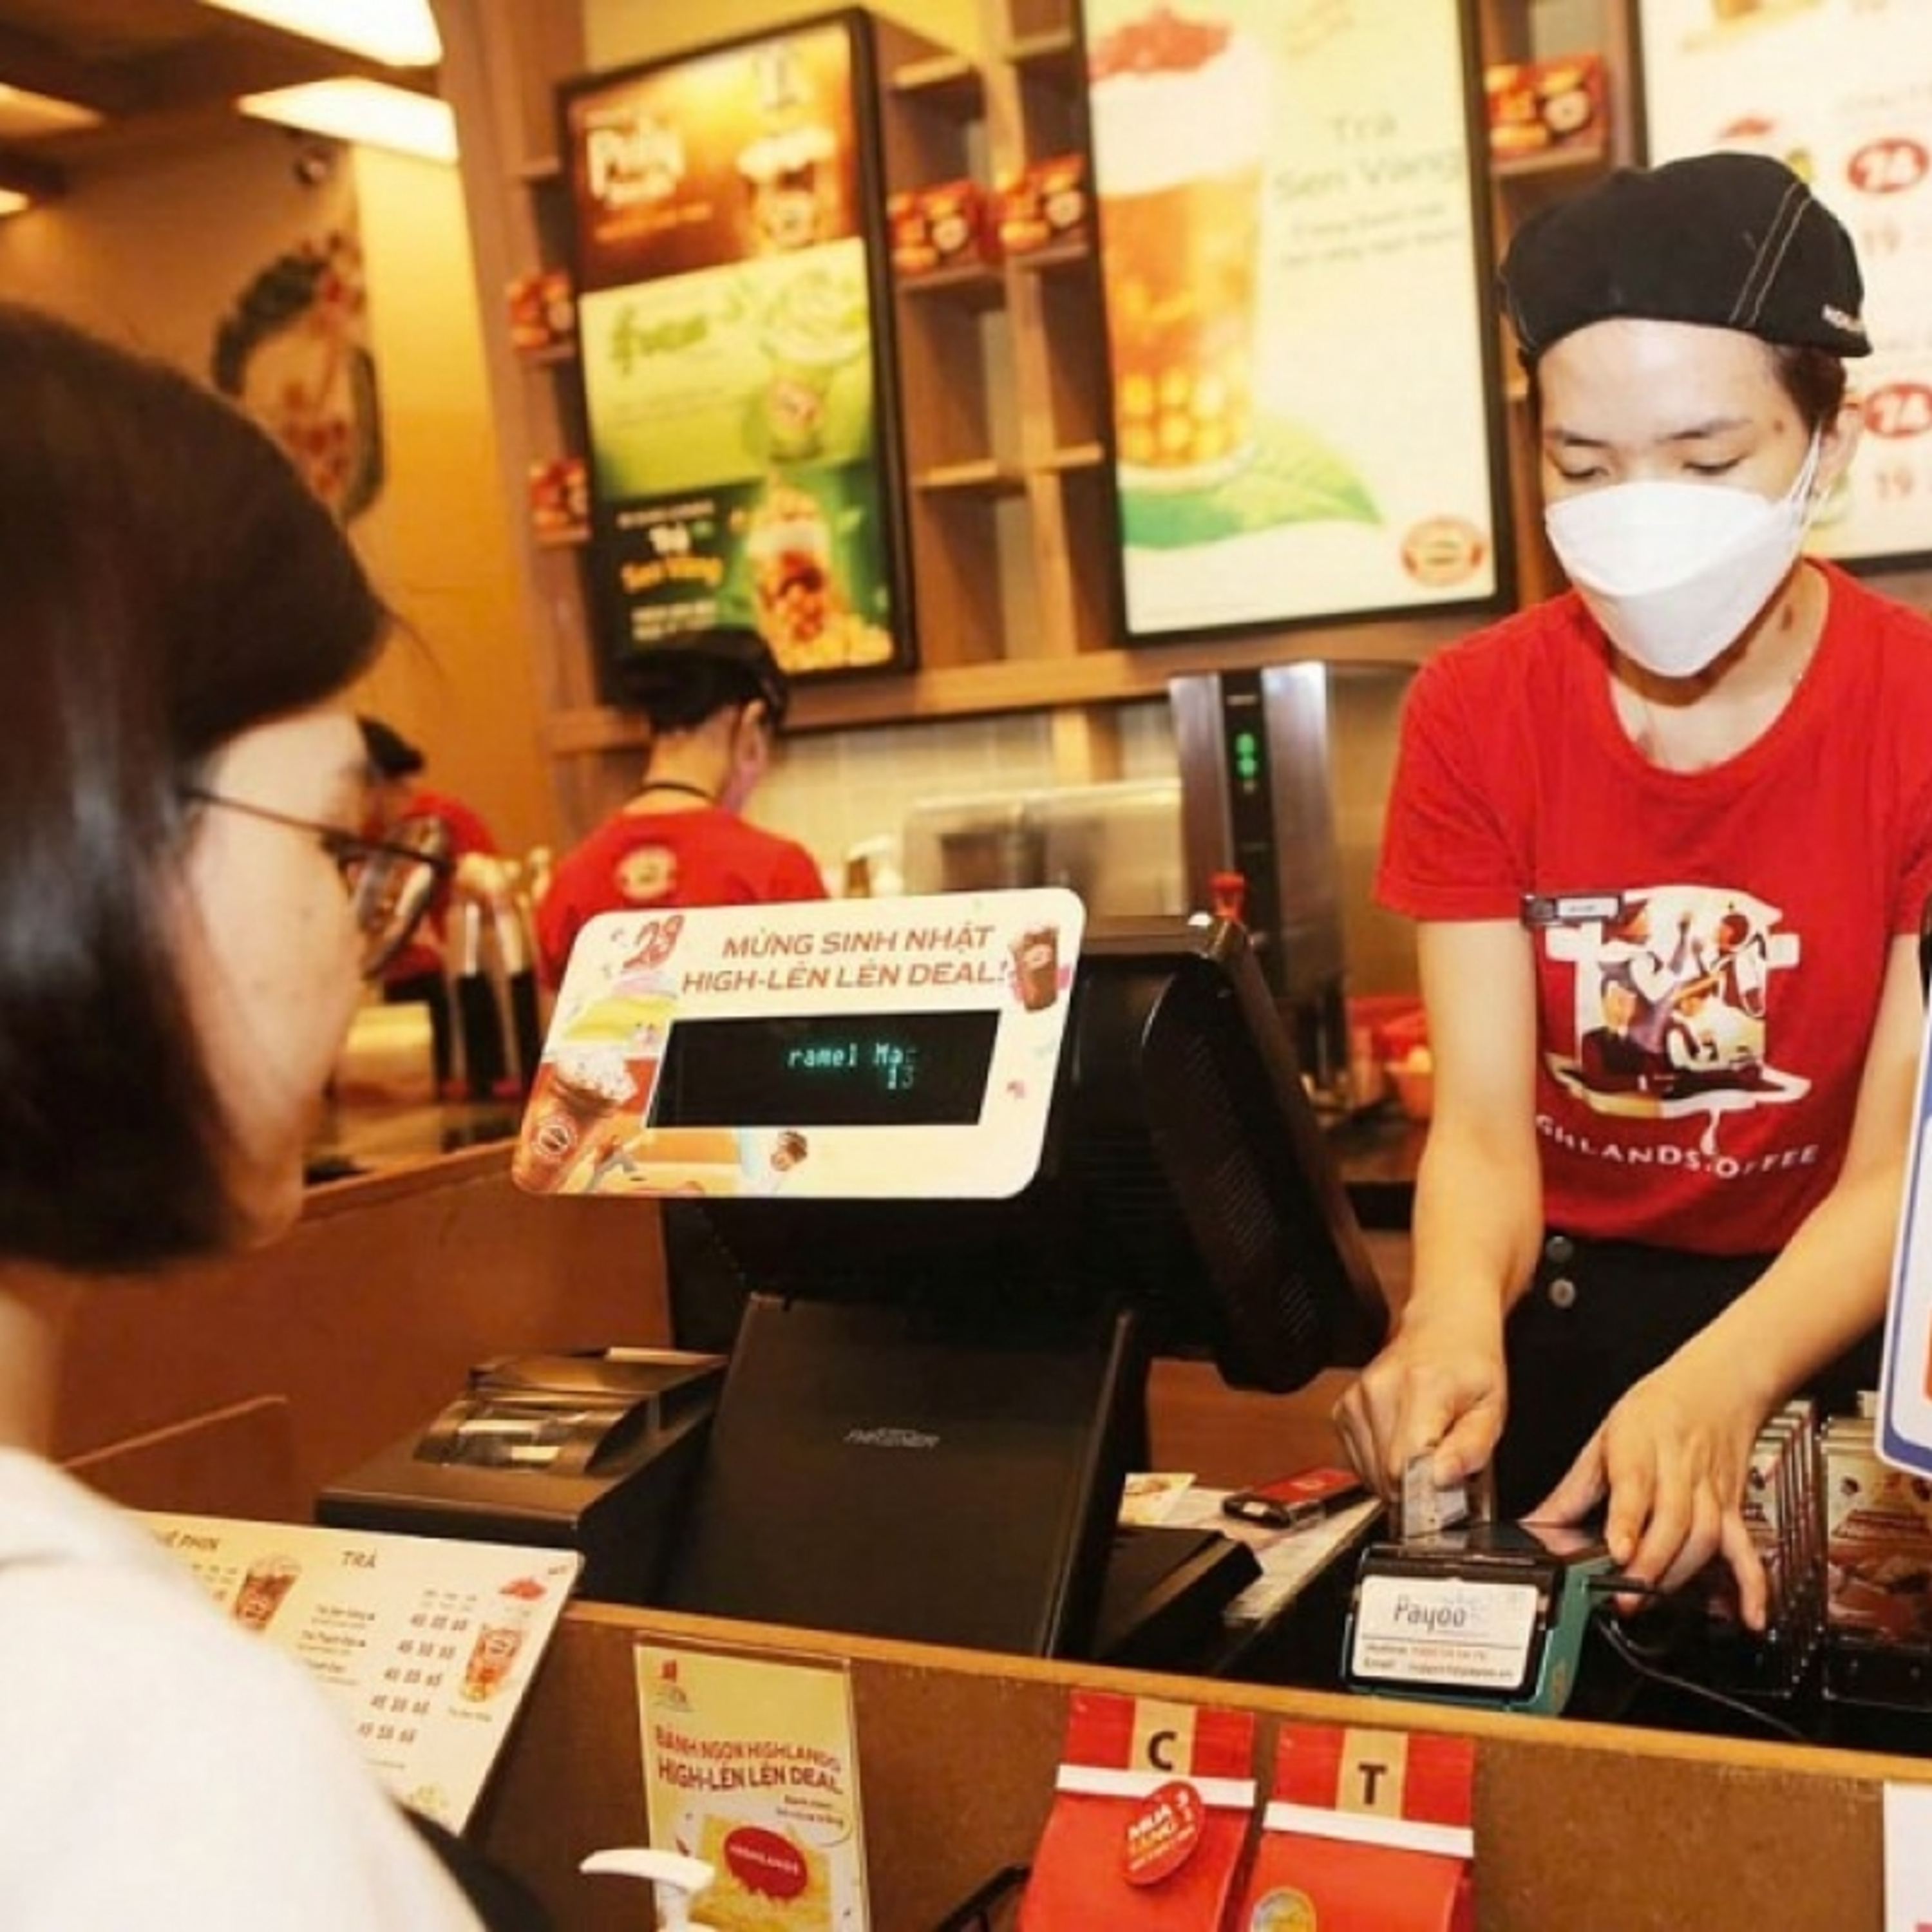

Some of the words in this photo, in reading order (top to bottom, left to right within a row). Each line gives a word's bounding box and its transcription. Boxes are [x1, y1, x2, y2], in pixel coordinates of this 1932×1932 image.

[820, 930, 896, 954] SINH
[905, 920, 996, 954] NHẬT
[908, 960, 1008, 985] DEAL!
[788, 1043, 858, 1068] ramel
[1394, 1594, 1466, 1631] Payoo
[1148, 1730, 1179, 1770] C
[1358, 1763, 1387, 1804] T
